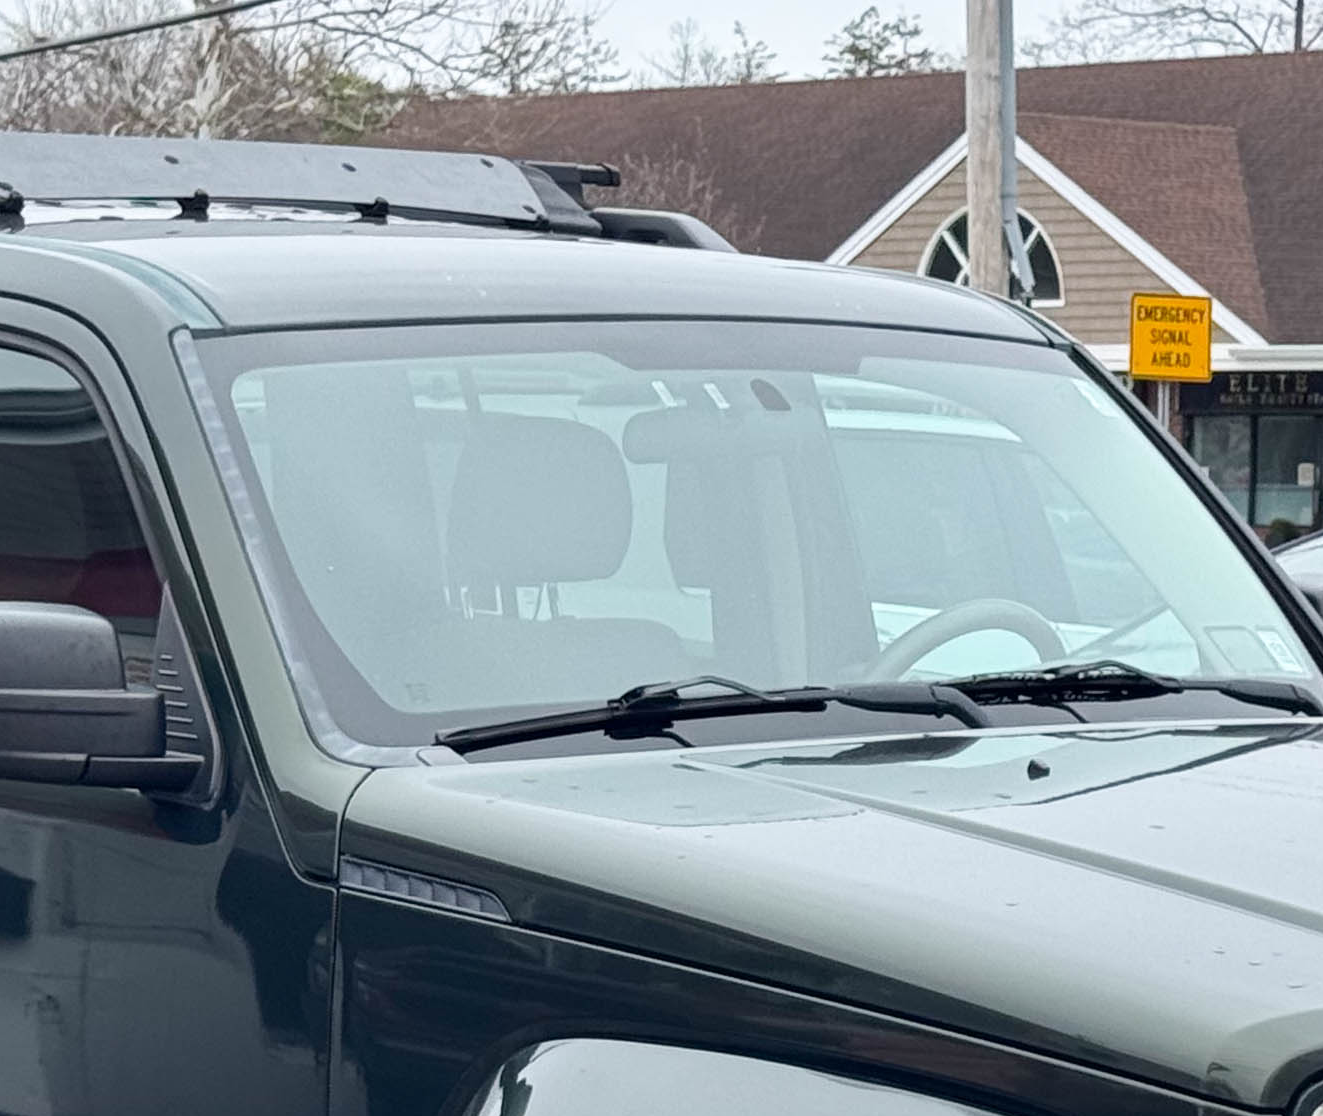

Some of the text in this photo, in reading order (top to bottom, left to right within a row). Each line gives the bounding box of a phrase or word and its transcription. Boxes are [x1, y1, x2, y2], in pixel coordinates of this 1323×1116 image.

[1136, 304, 1206, 324] EMERGENCY
[1149, 328, 1193, 346] SIGNAL
[1150, 352, 1191, 368] AHEAD
[1229, 374, 1309, 393] ELITE
